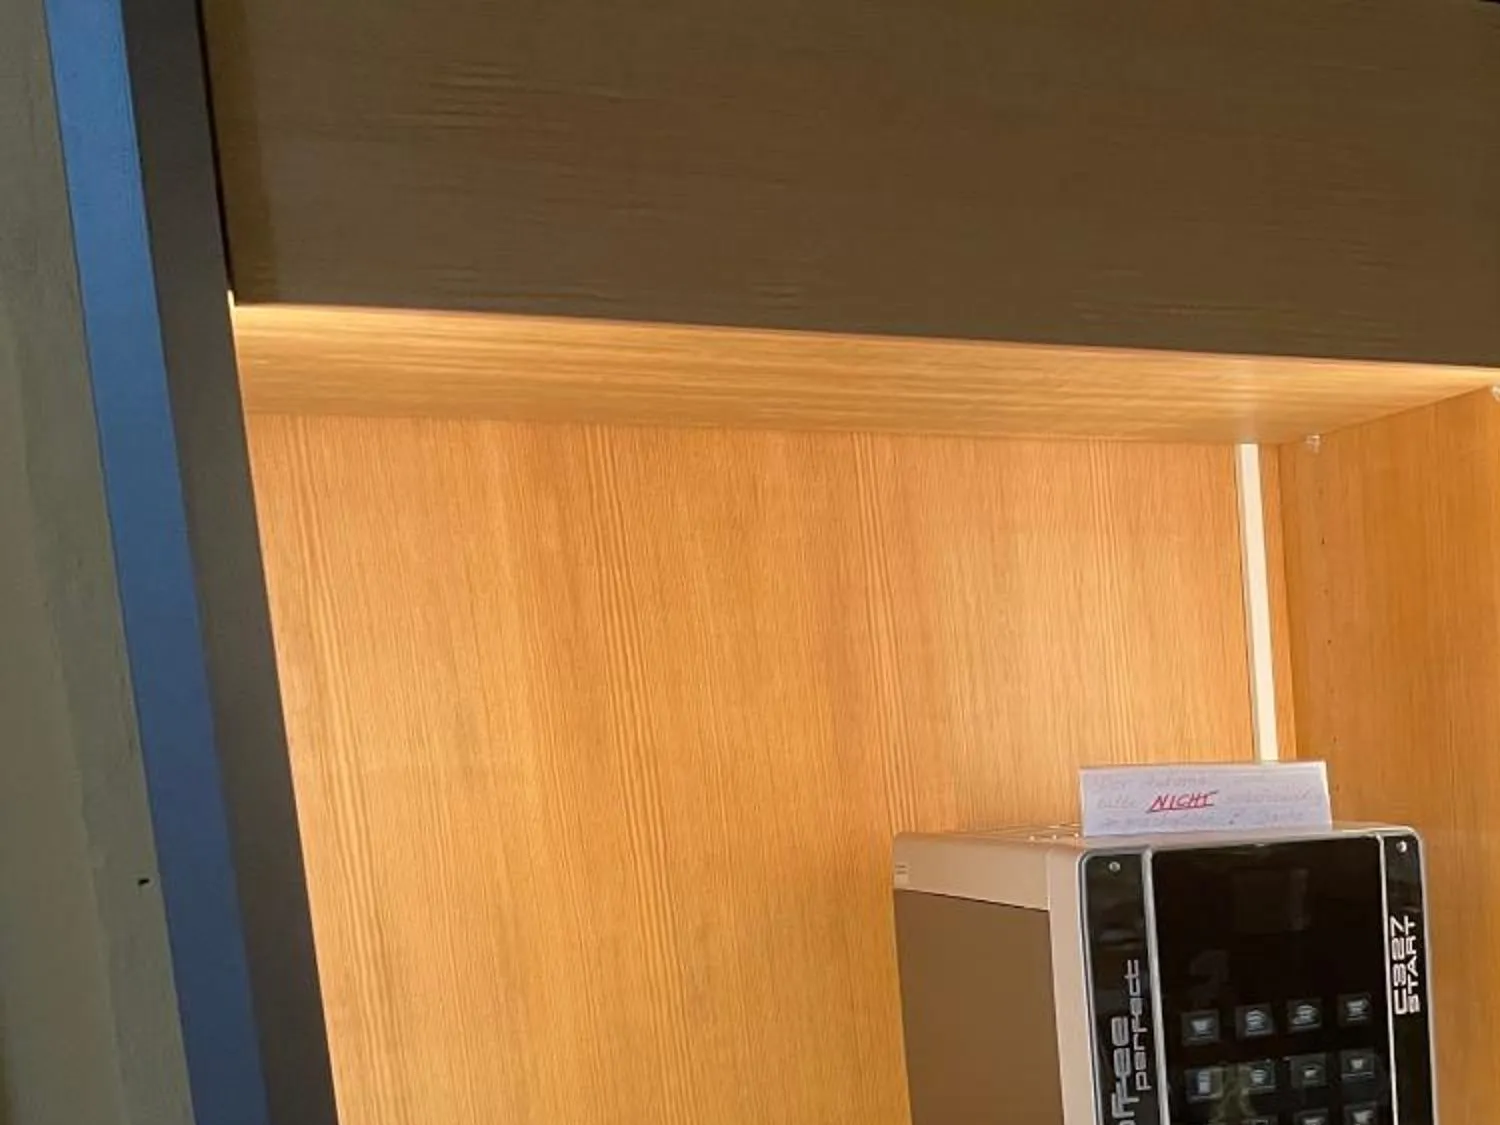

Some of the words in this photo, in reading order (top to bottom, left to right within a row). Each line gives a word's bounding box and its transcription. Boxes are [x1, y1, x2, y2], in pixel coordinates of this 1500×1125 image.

[1147, 789, 1219, 813] NICHT
[1403, 915, 1420, 1014] START
[1124, 959, 1152, 1091] perfect
